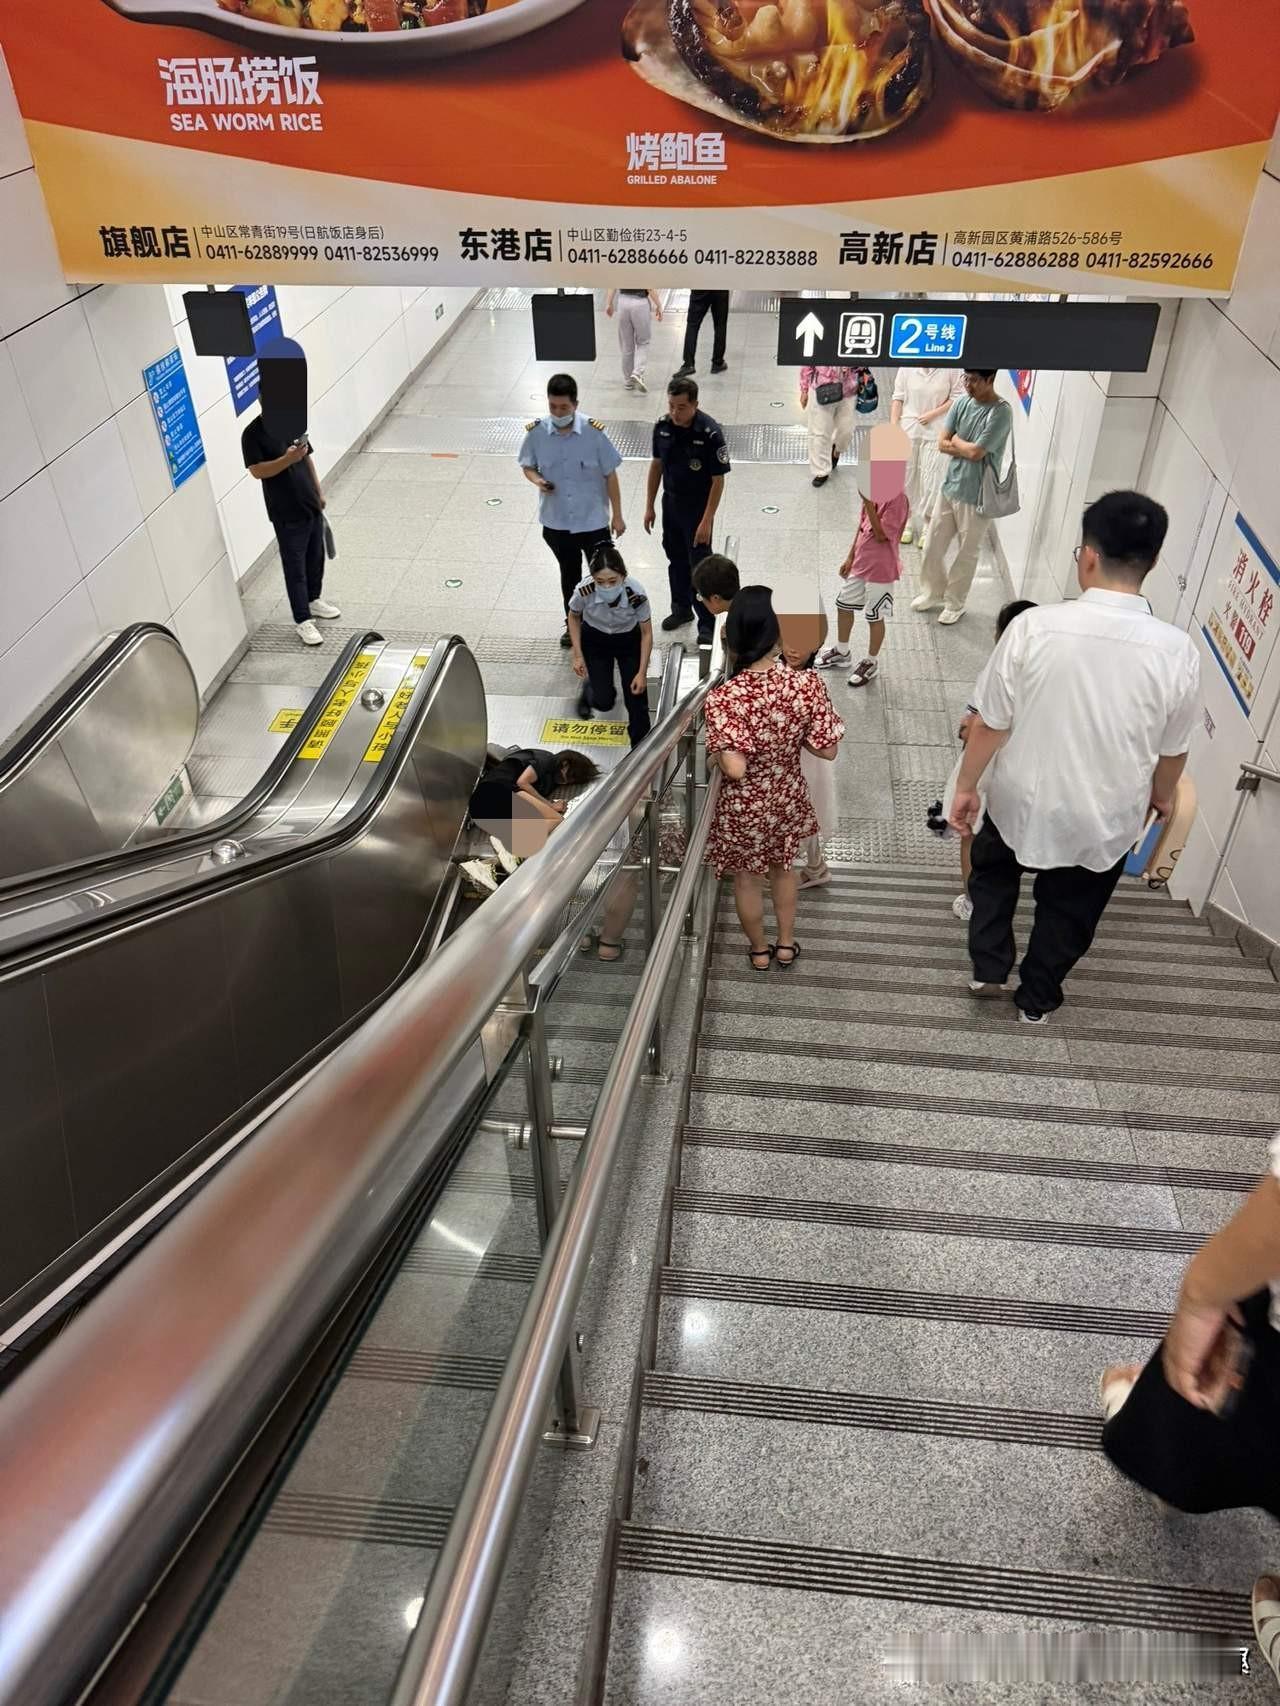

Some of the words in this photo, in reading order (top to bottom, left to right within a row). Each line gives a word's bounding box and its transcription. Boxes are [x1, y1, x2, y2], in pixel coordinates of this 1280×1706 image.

[158, 56, 323, 105] 海肠捞饭
[170, 113, 208, 131] SEA
[212, 113, 275, 131] WORM
[279, 113, 323, 131] RICE
[626, 132, 728, 171] 烤鲍鱼
[627, 175, 667, 185] GRILLED
[670, 175, 717, 185] ABALONE
[201, 224, 384, 241] 中山区常青街19号(日航饭店身后)
[567, 228, 687, 243] 中山区勤俭街23-4-5
[953, 230, 1123, 246] 高新园区黄浦路526-586号
[99, 225, 192, 259] 旗舰店
[459, 228, 552, 262] 东港店
[839, 231, 939, 266] 高新店
[206, 244, 318, 261] 0411-62889999
[325, 246, 439, 262] 0411-82536999
[568, 248, 688, 265] 0411-62886666
[695, 249, 818, 267] 0411-82283888
[952, 252, 1079, 268] 0411-62886288
[1086, 252, 1213, 269] 0411-82592666
[925, 344, 945, 352] Line
[947, 344, 953, 352] 2
[1233, 548, 1273, 627] 消火栓
[1239, 626, 1253, 655] 119
[552, 723, 626, 736] 请勿停留
